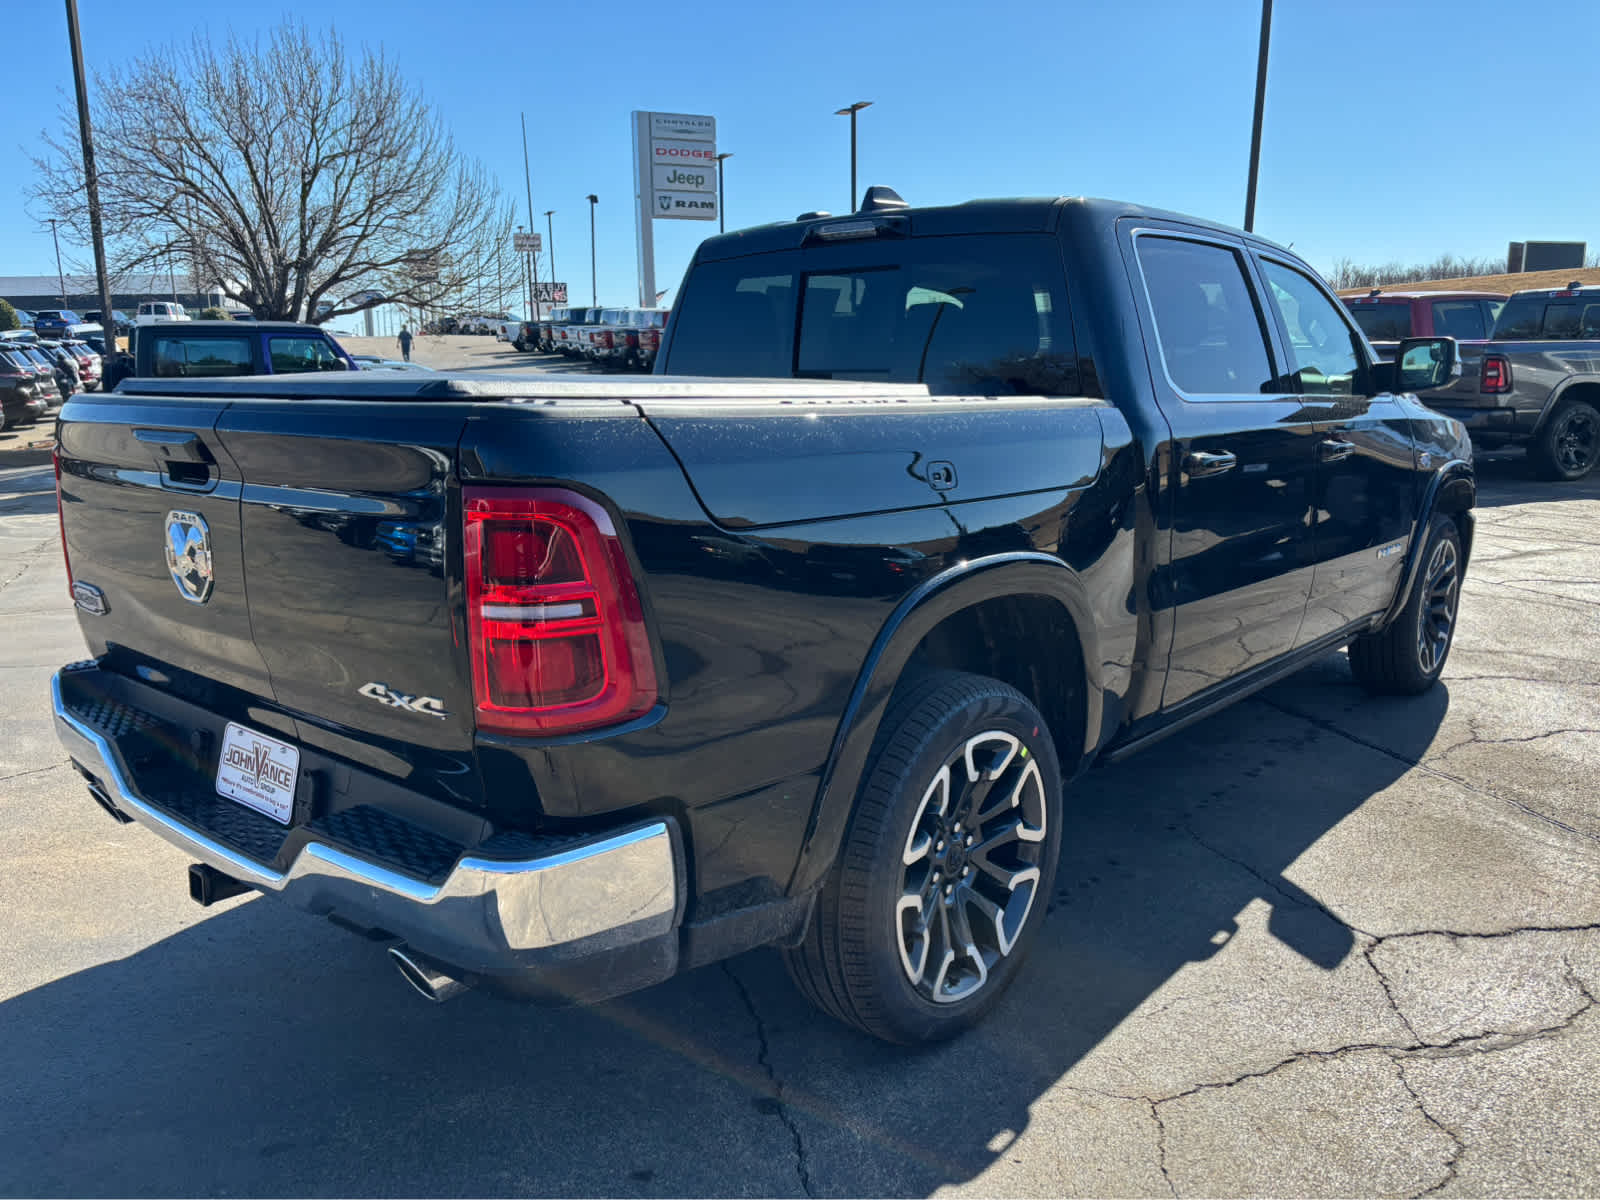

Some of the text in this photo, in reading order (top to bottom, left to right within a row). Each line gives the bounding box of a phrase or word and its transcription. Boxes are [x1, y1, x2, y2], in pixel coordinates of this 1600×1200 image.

[655, 147, 714, 159] DODGE
[666, 169, 705, 187] Jeep
[675, 200, 715, 208] RAM
[172, 512, 198, 522] RAM
[225, 746, 292, 788] JOHN VANCE
[241, 774, 254, 785] AUTO
[260, 782, 276, 793] GROUP
